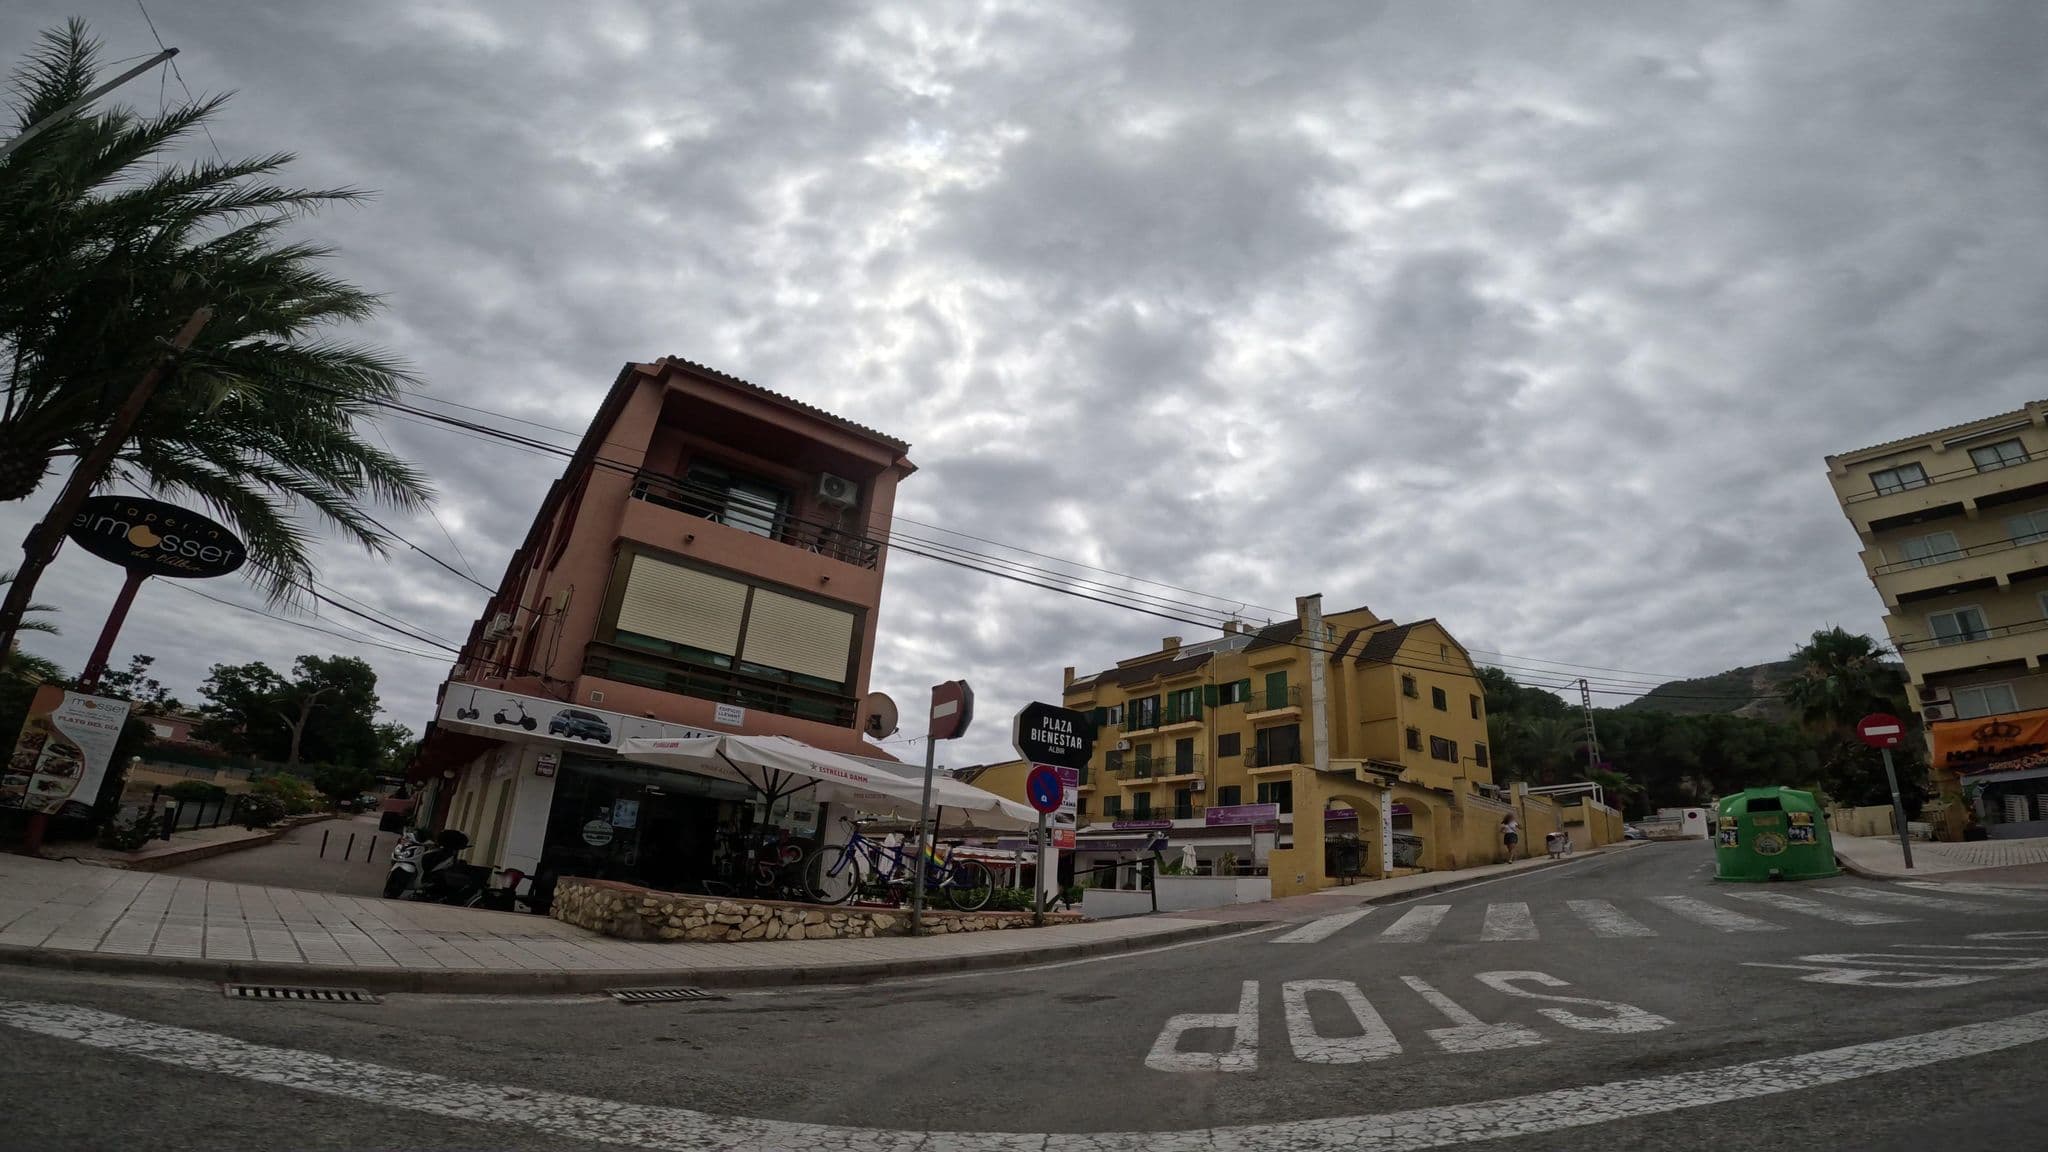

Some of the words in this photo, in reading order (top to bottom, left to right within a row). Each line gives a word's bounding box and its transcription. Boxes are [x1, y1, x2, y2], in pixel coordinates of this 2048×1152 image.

[58, 715, 85, 726] PLATO
[87, 720, 103, 728] DEL
[1043, 716, 1072, 734] PLAZA
[1031, 728, 1083, 750] BIENESTAR
[1048, 745, 1066, 755] ALBIR
[819, 766, 848, 780] ESTRELLA
[849, 773, 868, 784] DAMM
[1144, 970, 1677, 1073] STOP
